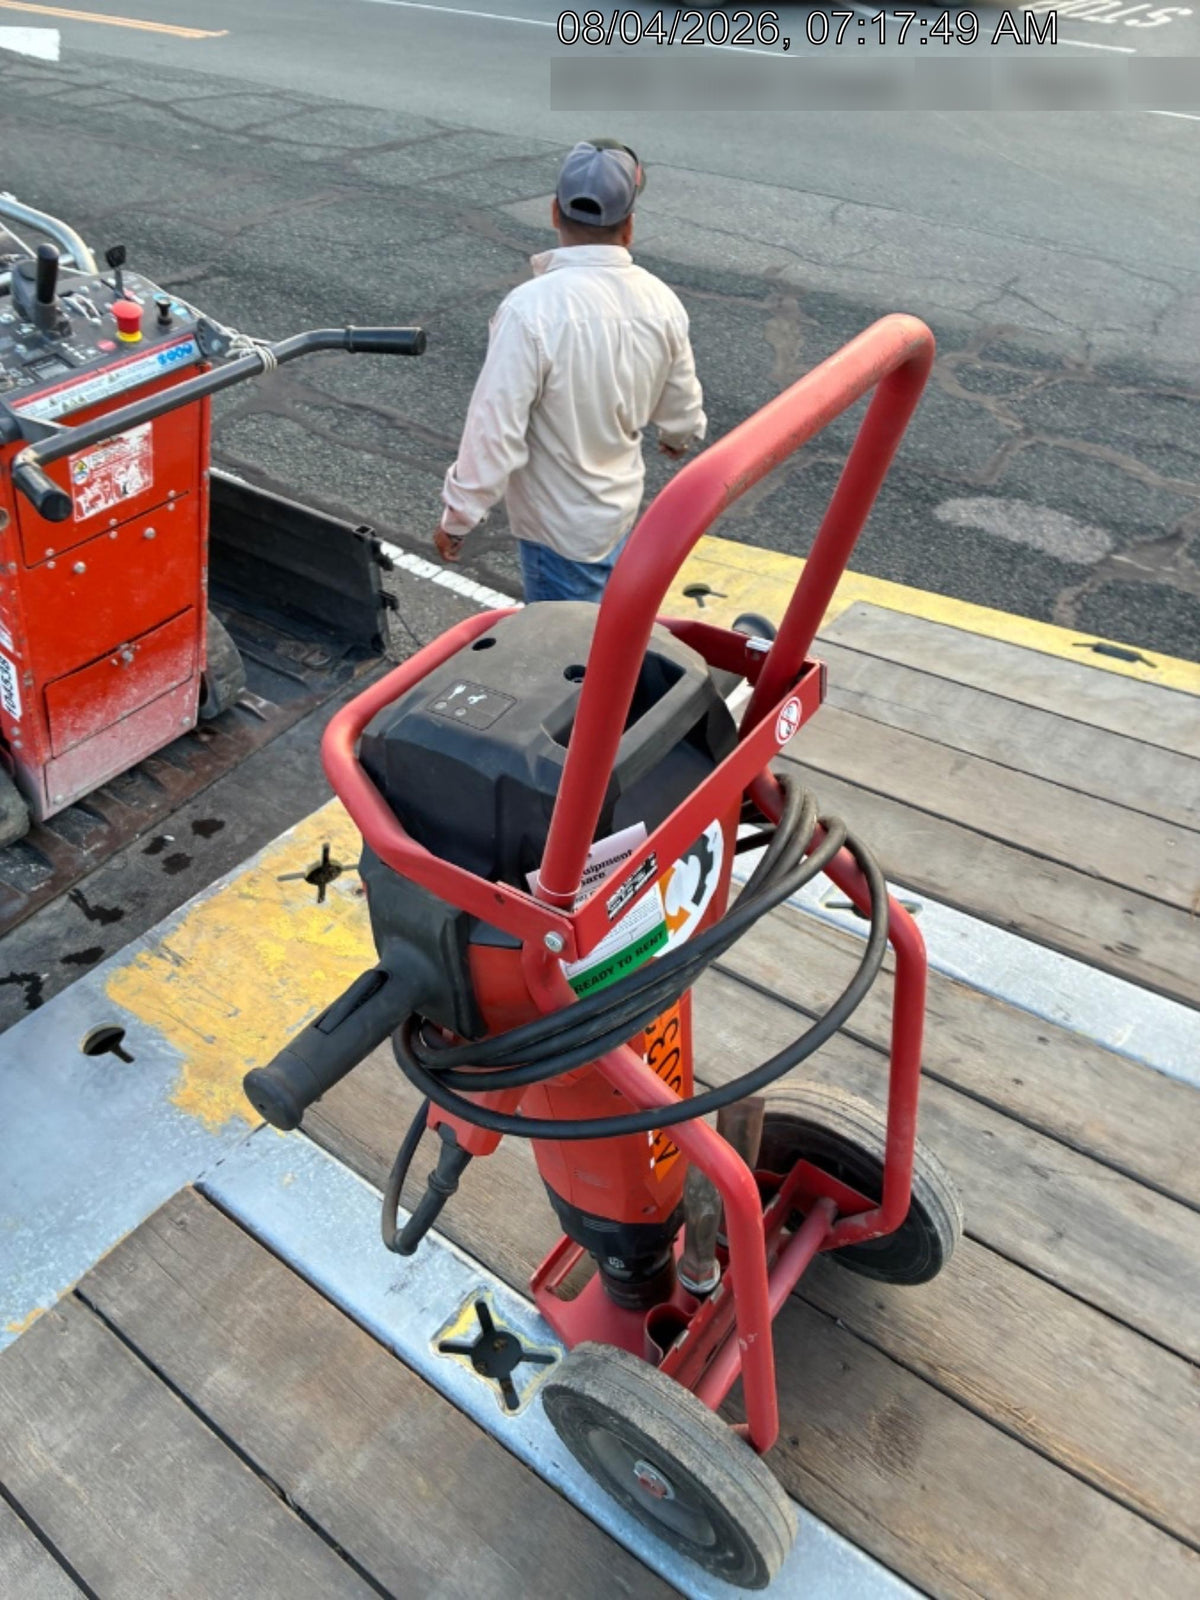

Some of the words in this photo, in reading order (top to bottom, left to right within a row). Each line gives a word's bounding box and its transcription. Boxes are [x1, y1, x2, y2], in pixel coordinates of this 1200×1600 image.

[574, 965, 614, 994] READY
[617, 955, 632, 968] TO
[635, 931, 663, 957] RENT
